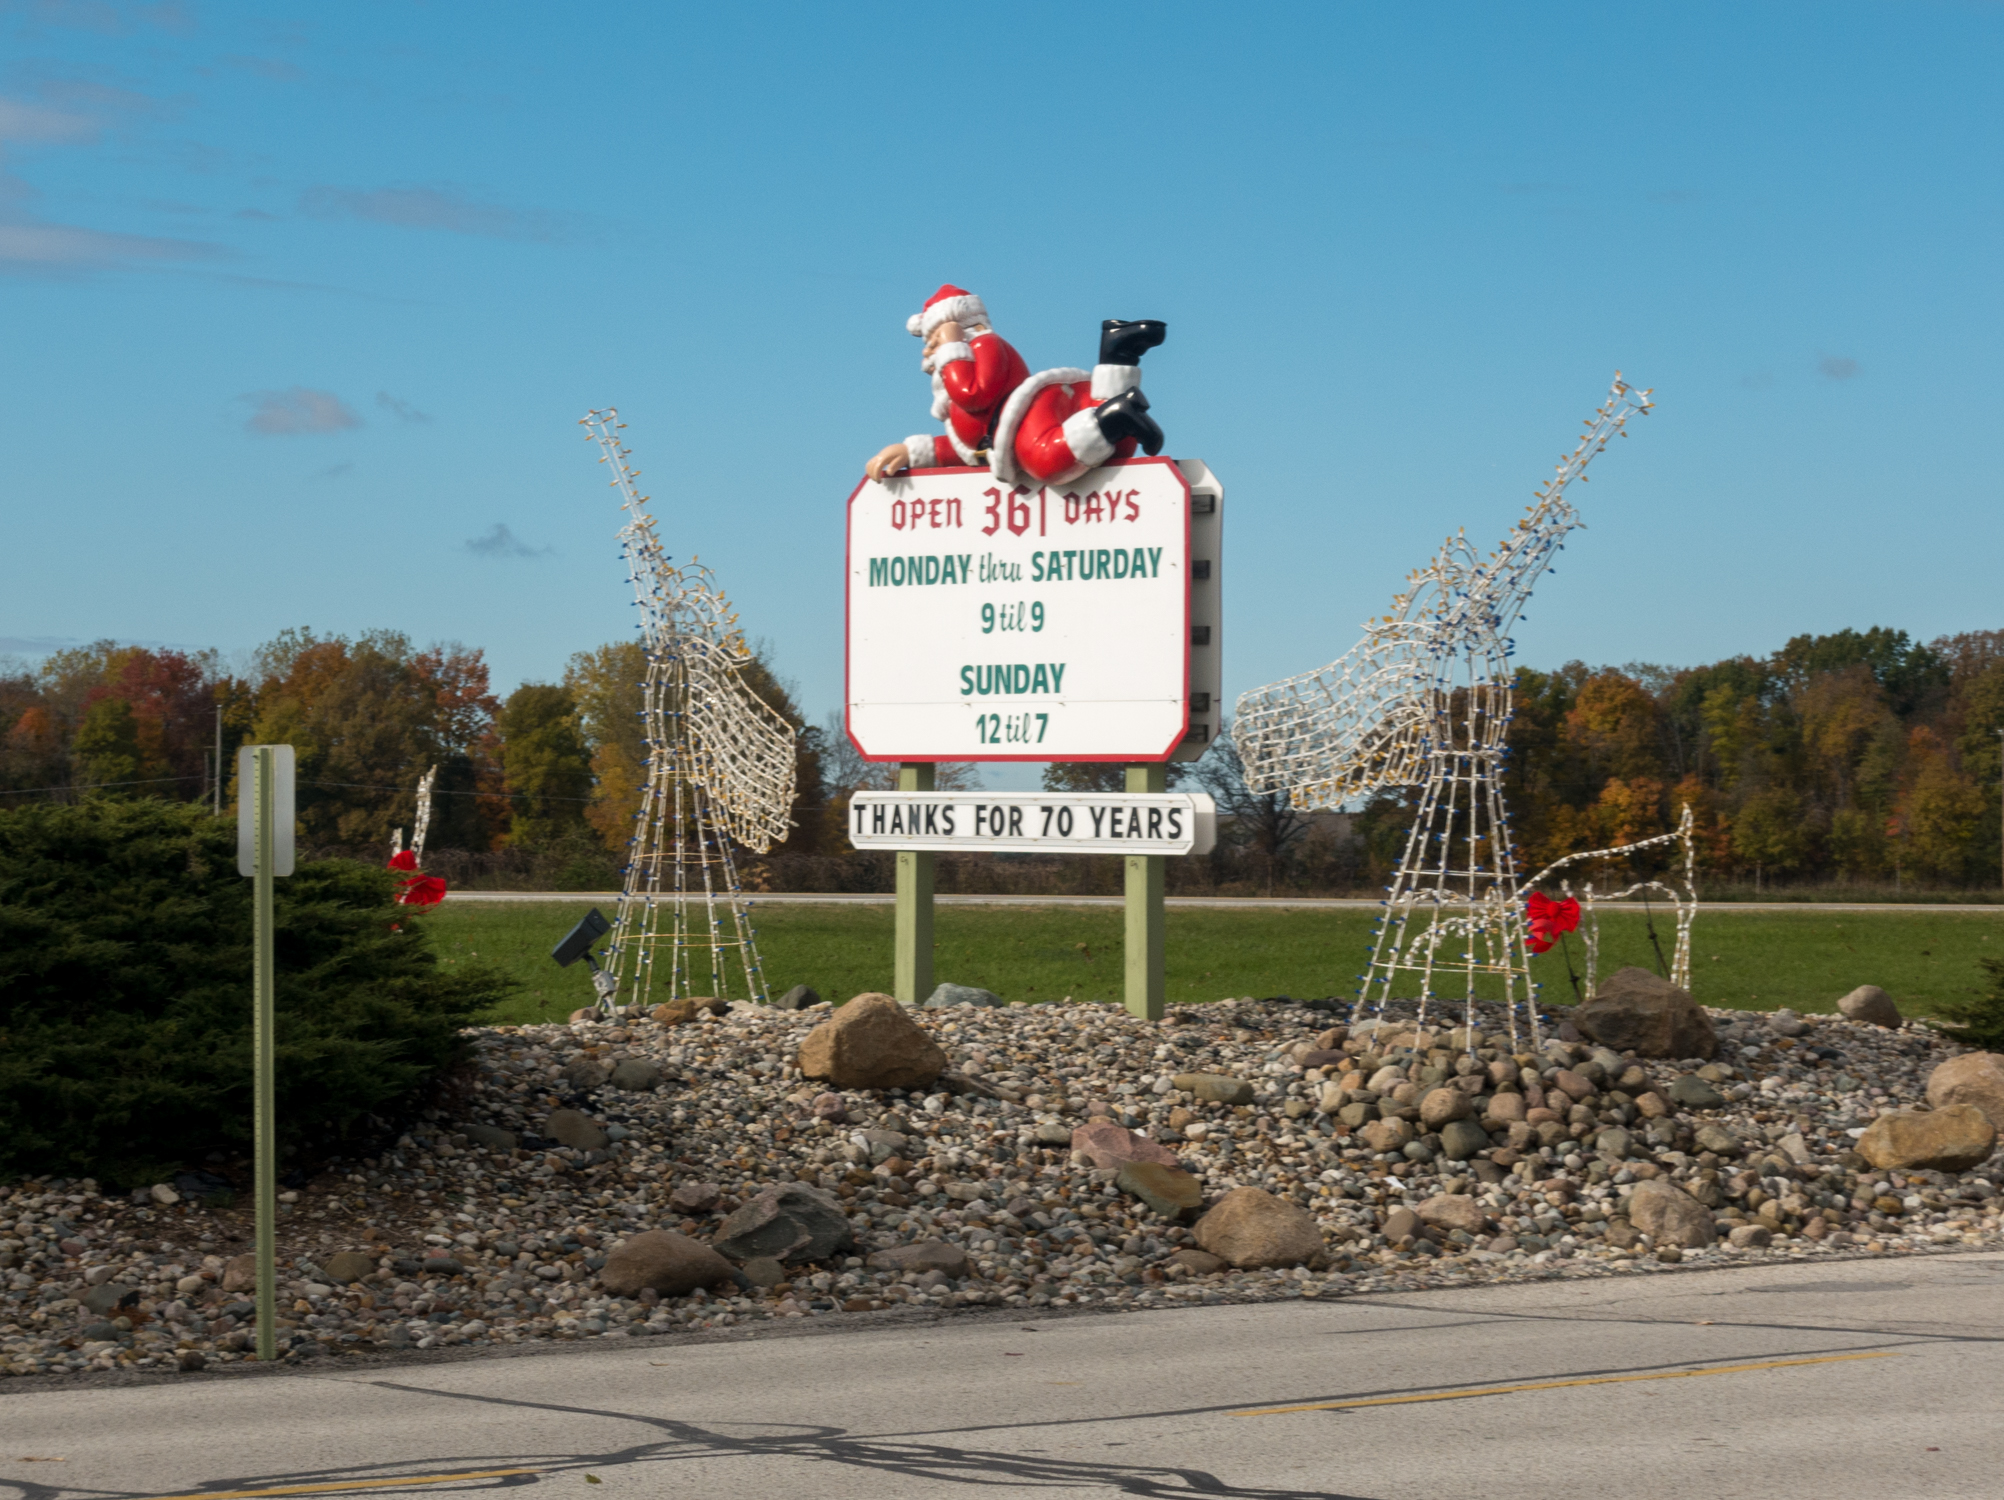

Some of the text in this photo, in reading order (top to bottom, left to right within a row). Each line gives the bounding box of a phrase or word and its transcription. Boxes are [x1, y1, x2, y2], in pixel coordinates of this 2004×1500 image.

[891, 484, 1141, 537] OPEN 361 DAYS
[870, 547, 1162, 587] MONDAY thru SATURDAY
[981, 601, 1045, 634] 9 til 9
[961, 663, 1065, 695] SUNDAY
[976, 713, 1049, 743] 12 til 7
[854, 804, 1182, 839] THANKS FOR 70 YEARS
